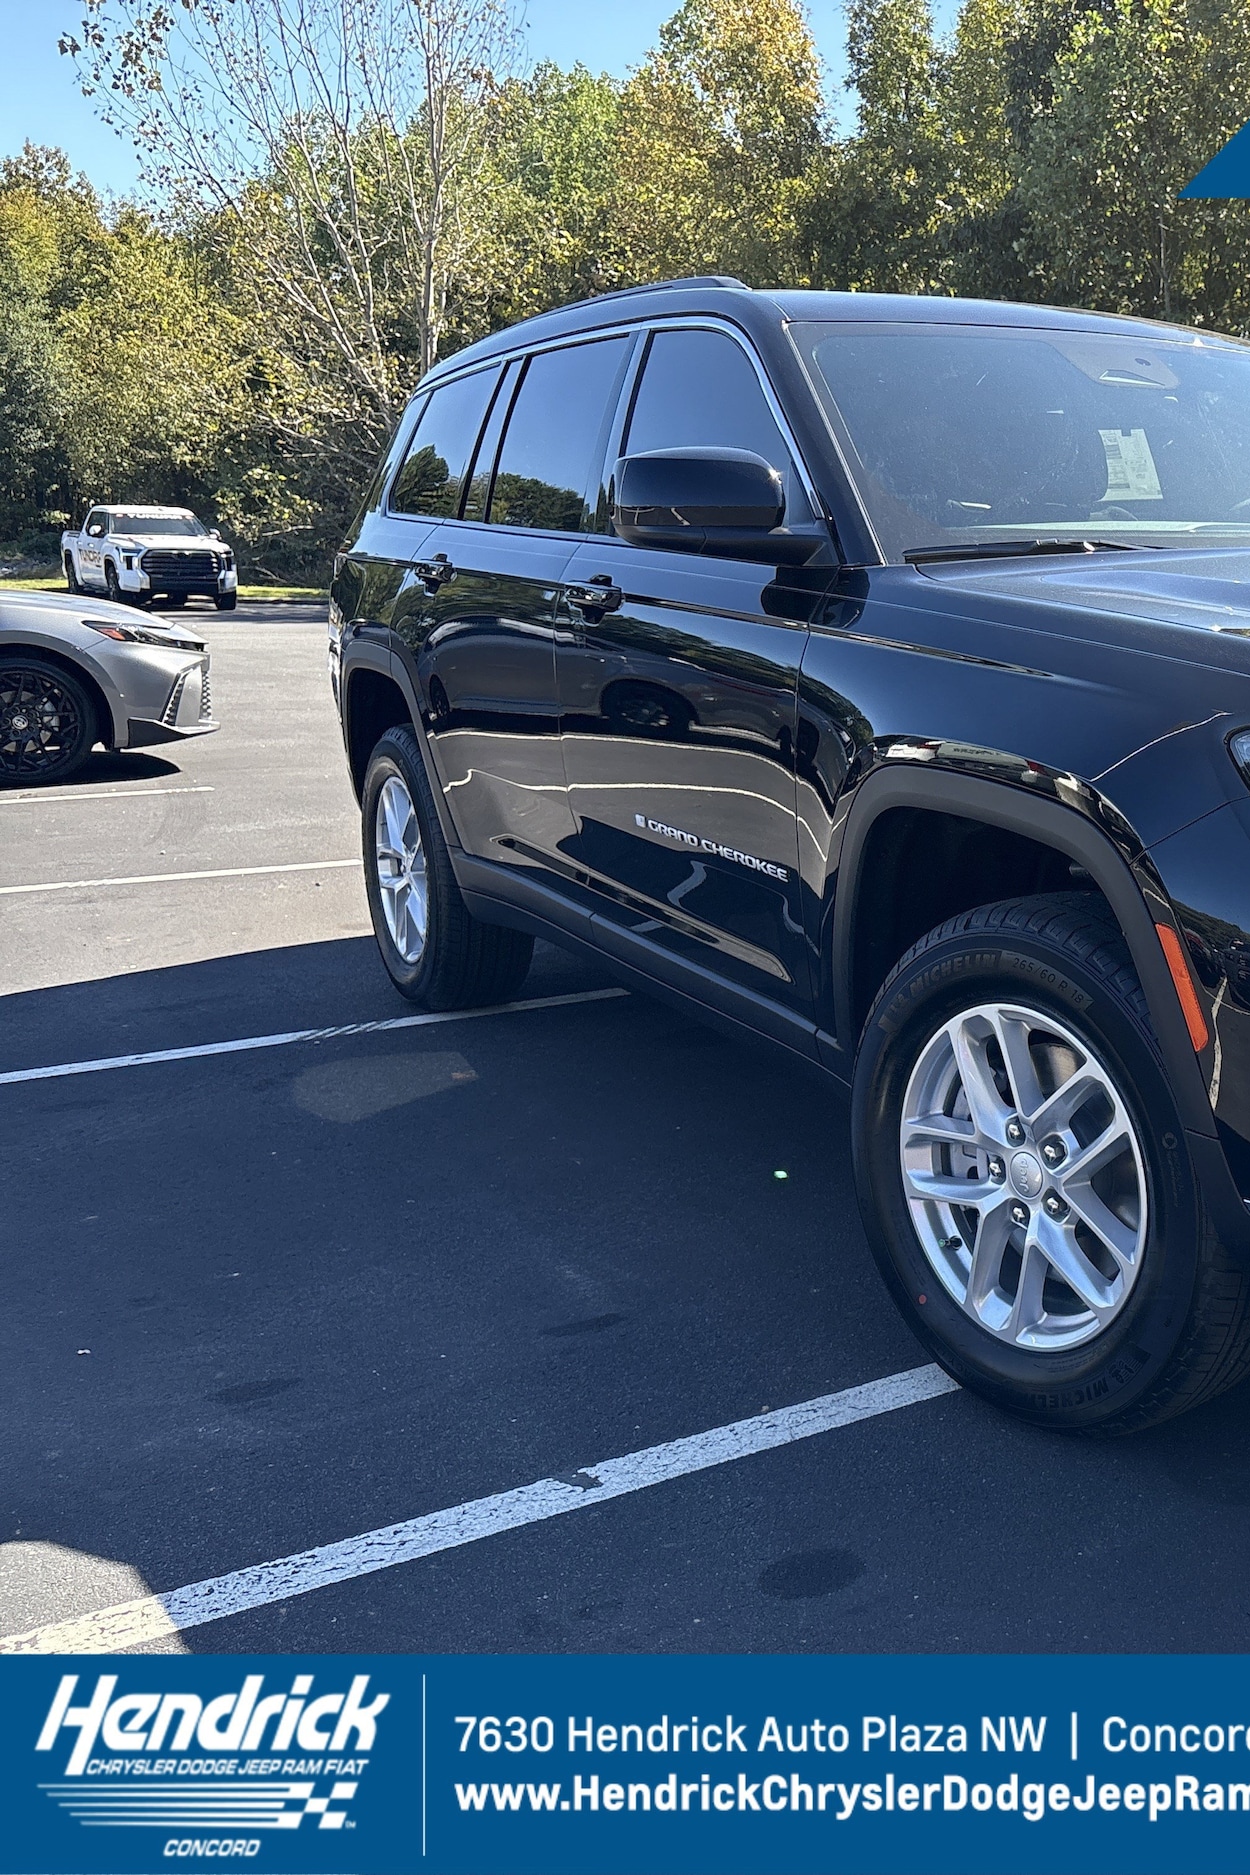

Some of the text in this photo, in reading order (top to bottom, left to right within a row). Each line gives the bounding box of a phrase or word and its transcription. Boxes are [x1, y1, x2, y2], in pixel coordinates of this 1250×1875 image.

[648, 819, 789, 883] GRAND CHEROKEE
[909, 953, 1085, 1004] MICHELIN 265/60 R 18
[1019, 1158, 1029, 1192] Jeep
